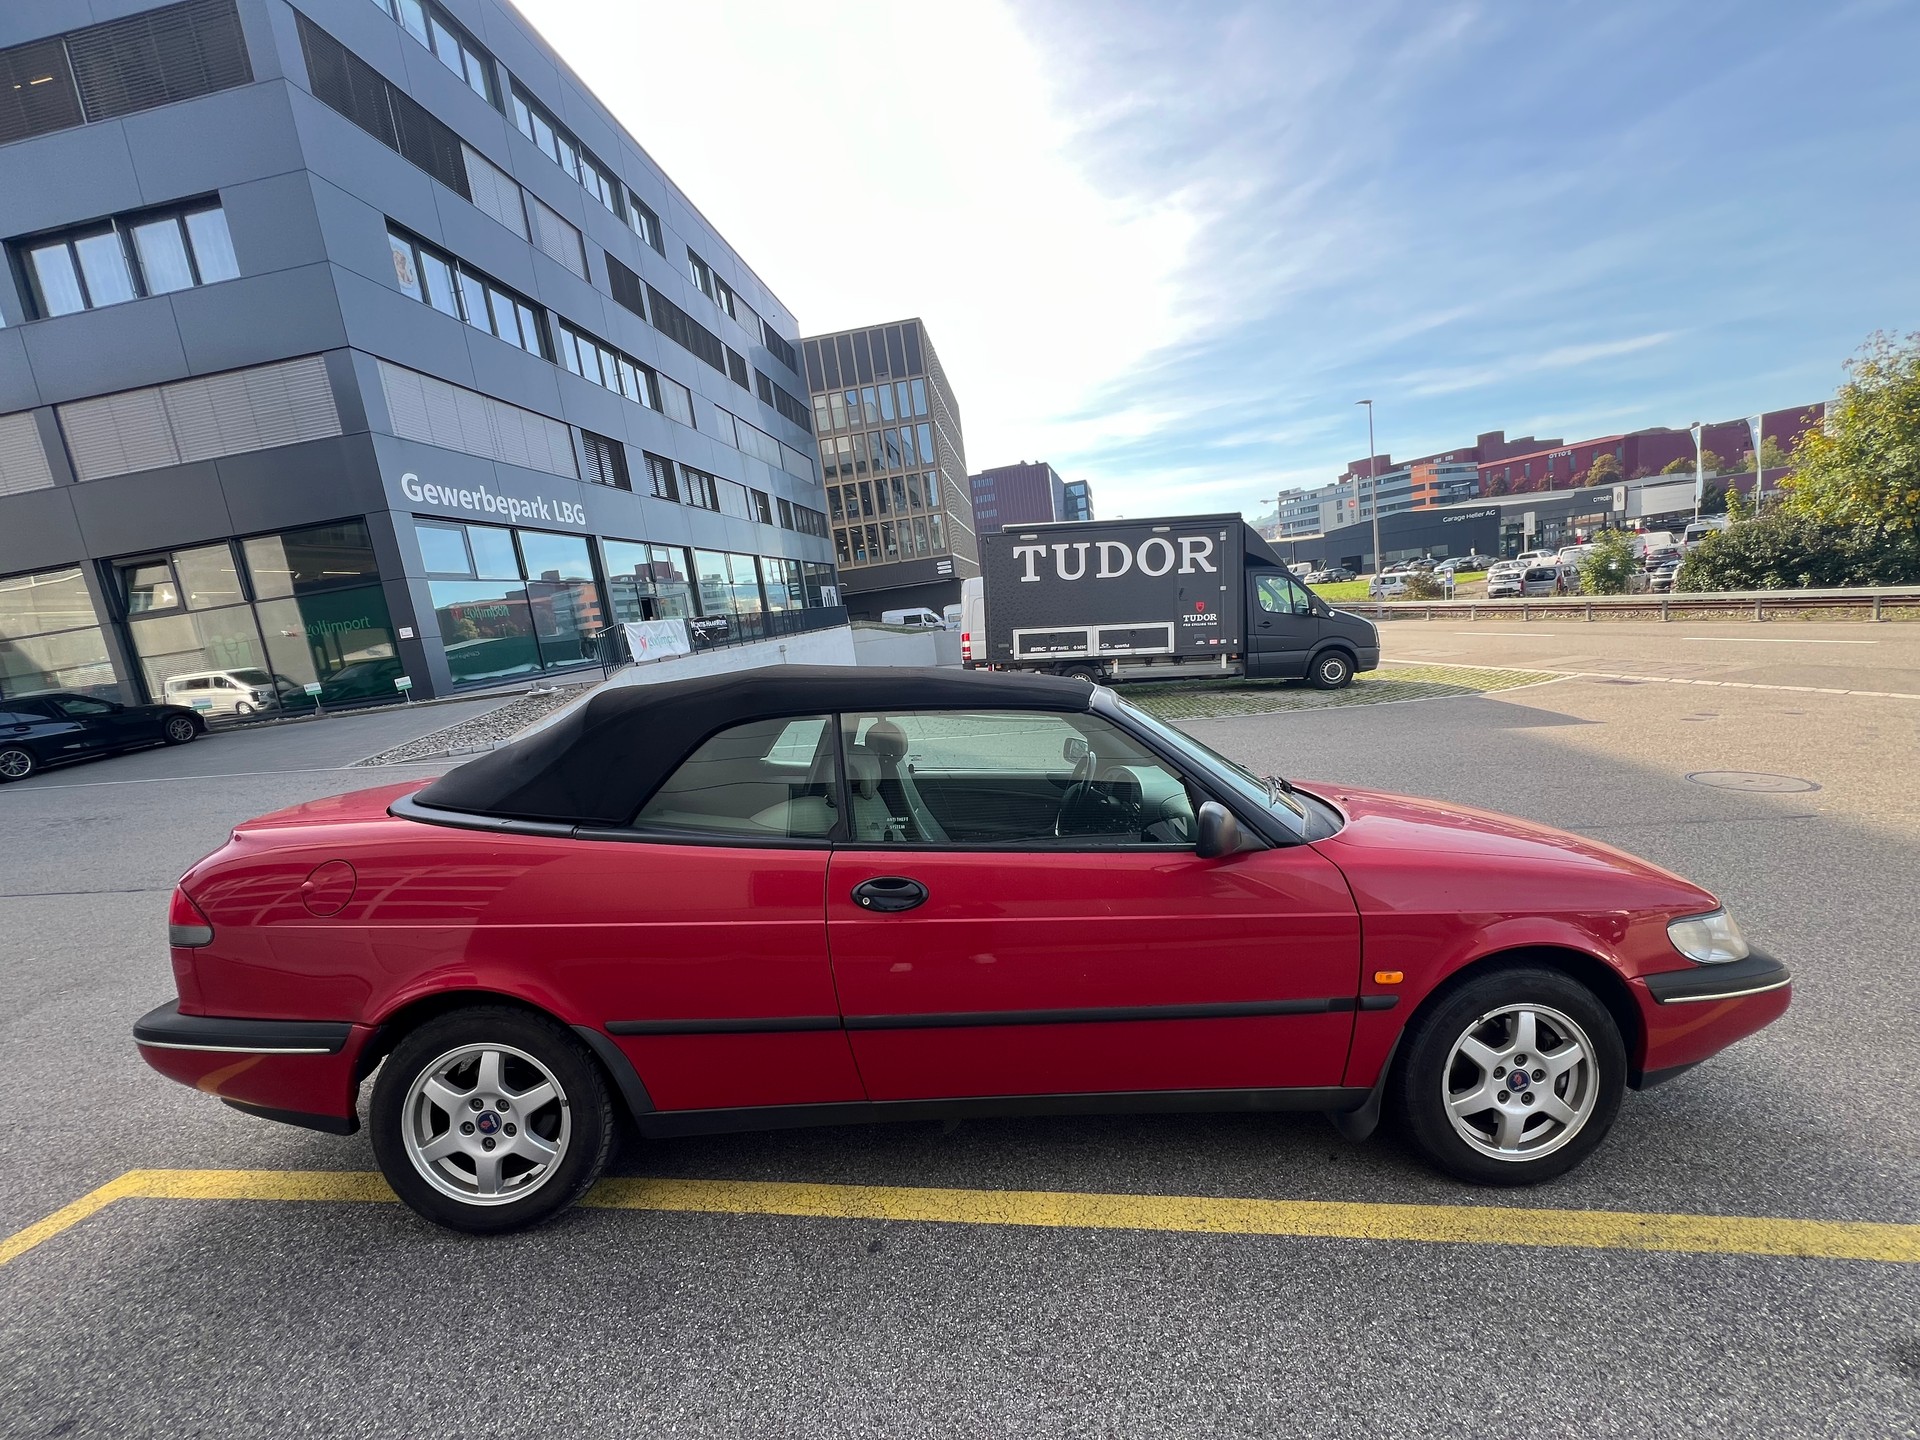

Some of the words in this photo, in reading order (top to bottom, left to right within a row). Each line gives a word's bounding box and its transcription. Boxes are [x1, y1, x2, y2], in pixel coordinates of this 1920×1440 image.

[1548, 450, 1572, 459] OTTO'S
[401, 473, 551, 522] Gewerbepark
[553, 500, 586, 525] LBG
[1013, 536, 1217, 582] TUDOR
[1183, 613, 1217, 622] TUDOR
